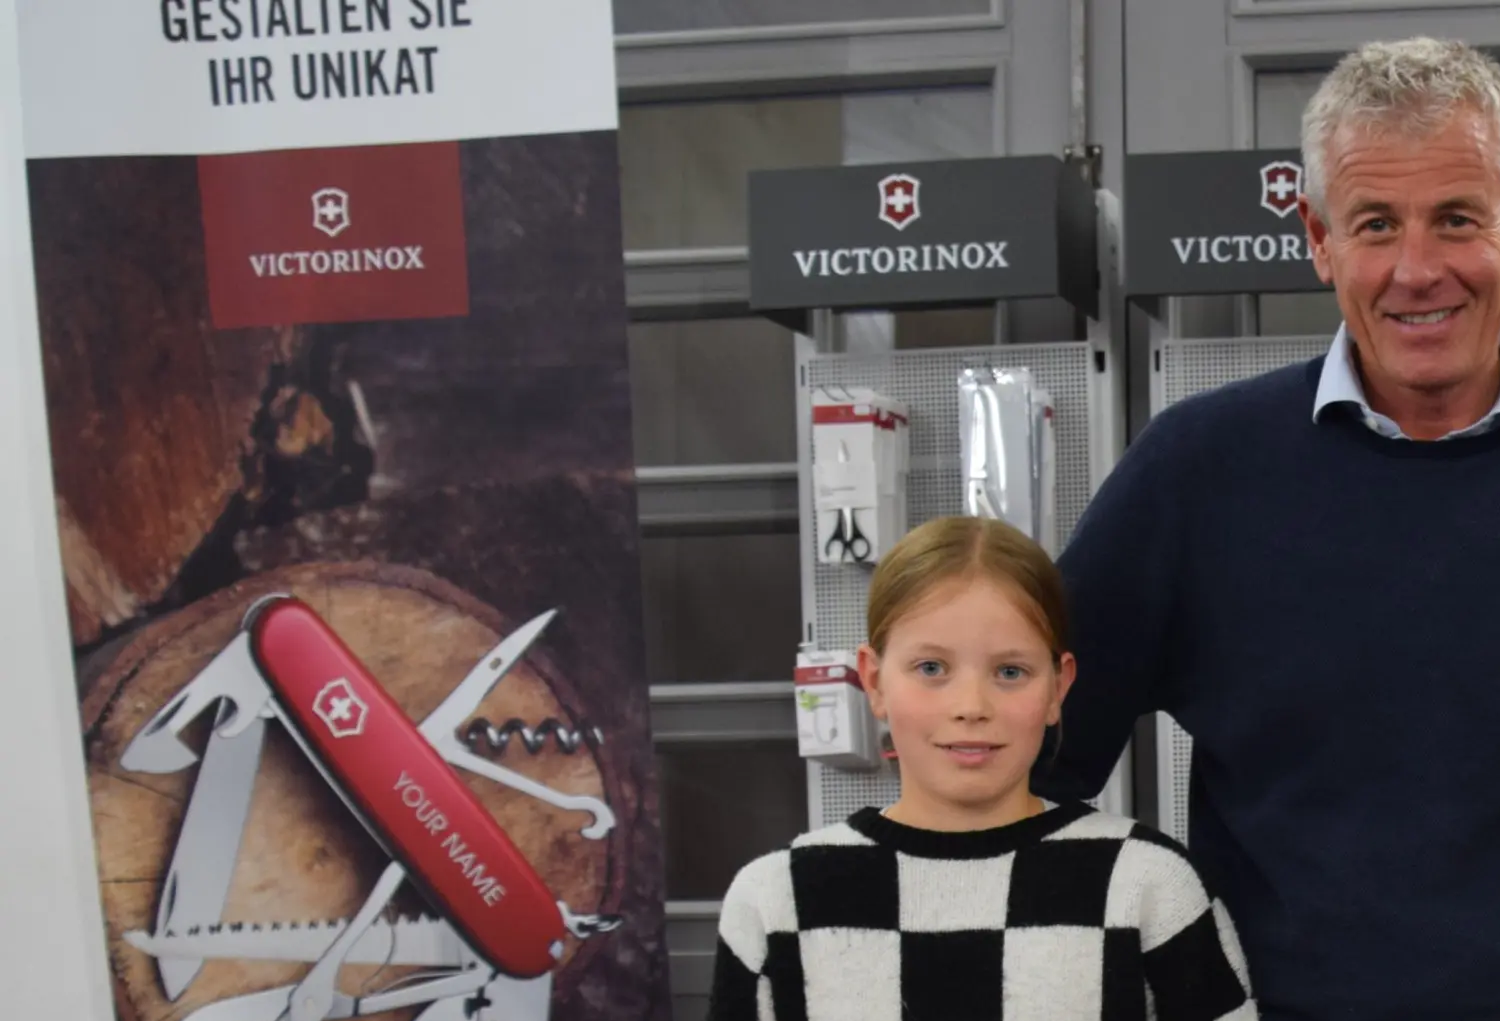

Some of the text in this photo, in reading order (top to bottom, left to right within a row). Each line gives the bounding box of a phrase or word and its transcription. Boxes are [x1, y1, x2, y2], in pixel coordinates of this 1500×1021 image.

[208, 46, 438, 107] IHR UNIKAT
[249, 246, 425, 277] VICTORINOX
[793, 241, 1010, 277] VICTORINOX
[393, 770, 507, 907] YOUR NAME
